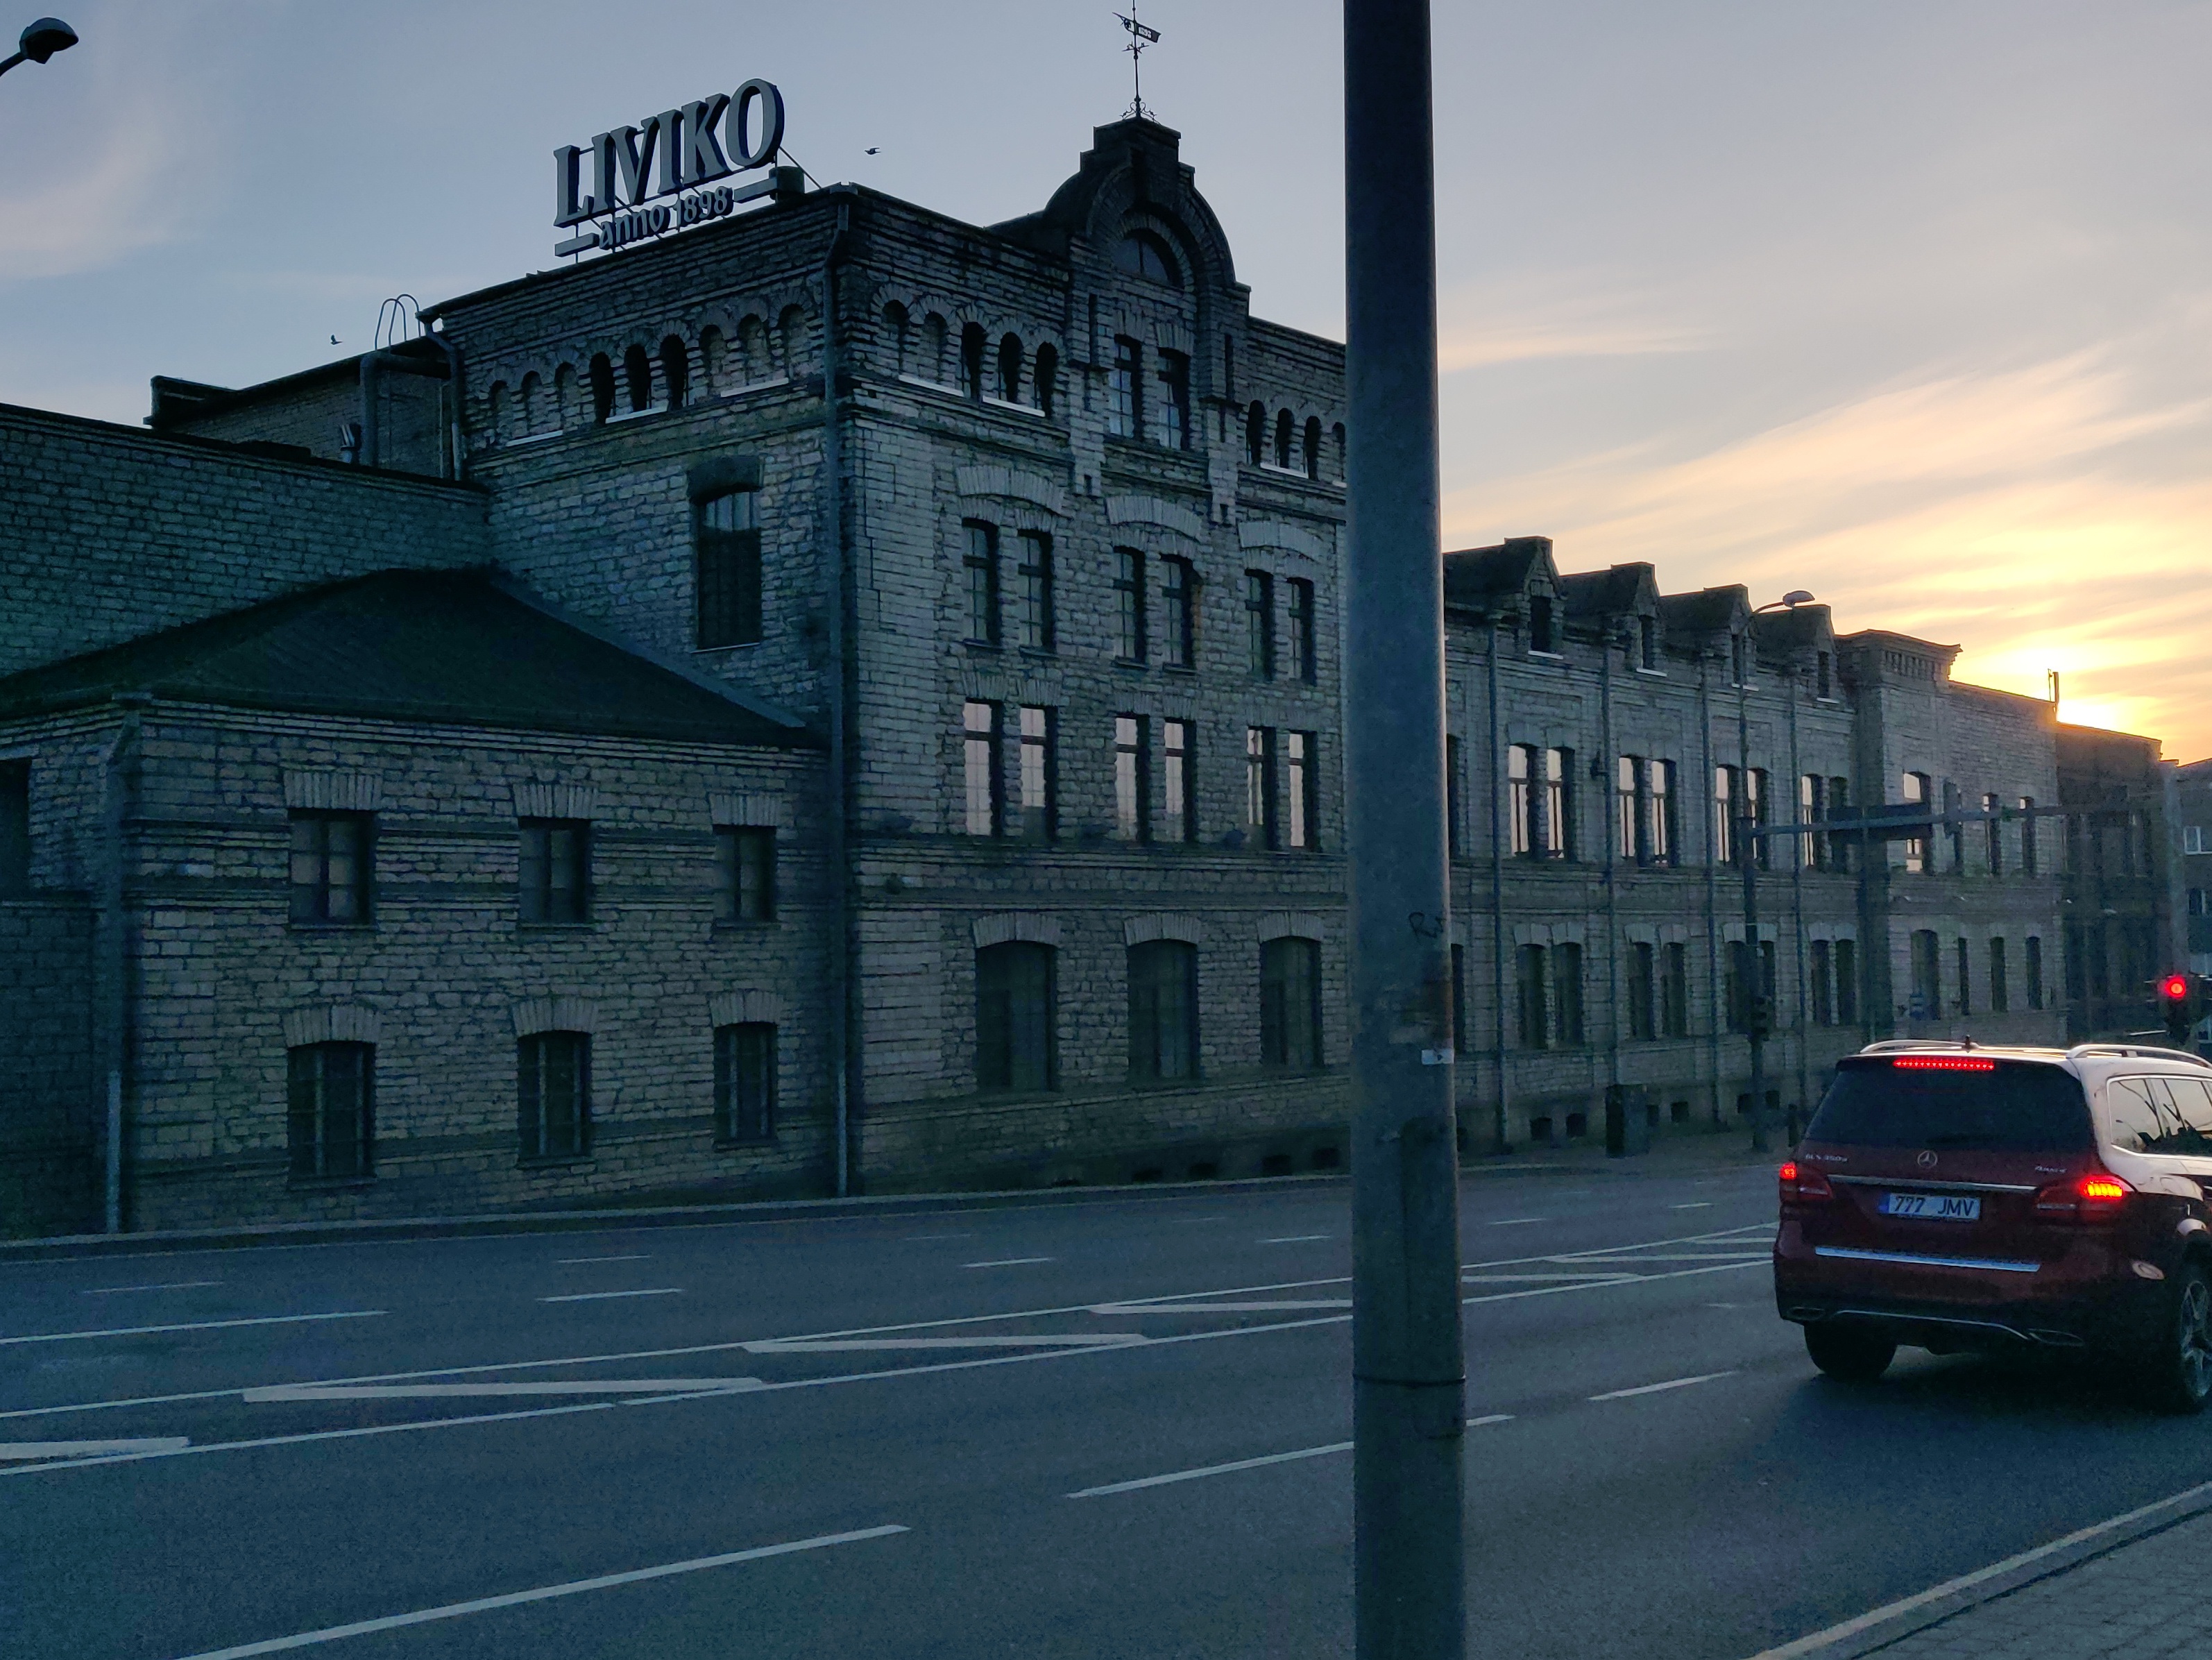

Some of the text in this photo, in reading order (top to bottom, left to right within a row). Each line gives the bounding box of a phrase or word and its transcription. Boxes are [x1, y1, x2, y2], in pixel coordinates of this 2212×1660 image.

[554, 78, 784, 228] LIVIKO
[599, 186, 733, 250] anno 1898
[1895, 1196, 1975, 1217] 777 JMV
